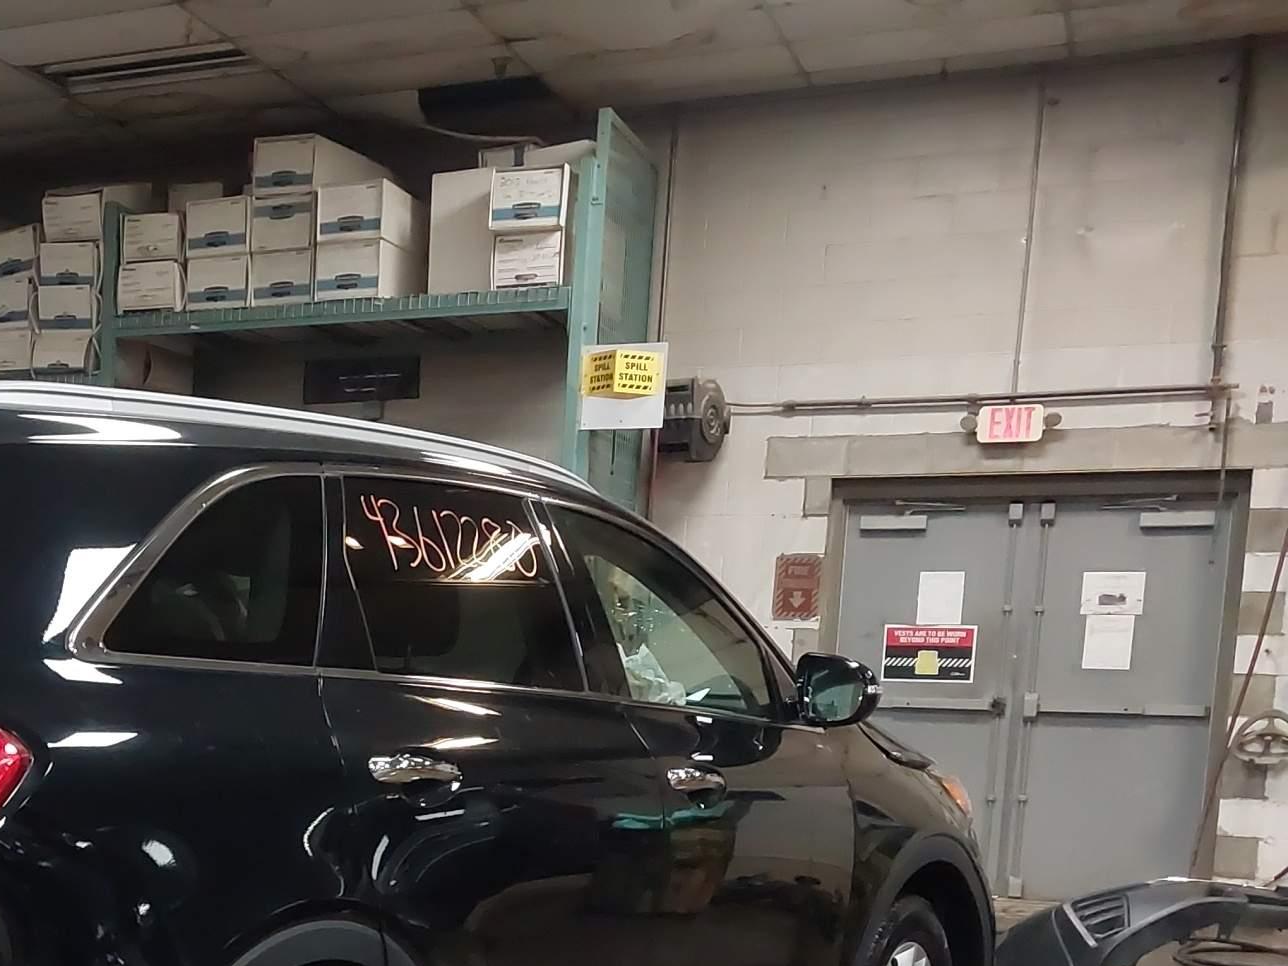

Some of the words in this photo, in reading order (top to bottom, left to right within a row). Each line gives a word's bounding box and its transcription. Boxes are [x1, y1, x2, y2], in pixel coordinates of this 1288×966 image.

[594, 361, 611, 372] SPILL
[625, 361, 649, 372] SPILL
[618, 372, 653, 383] STATION
[989, 407, 1036, 439] EXIT
